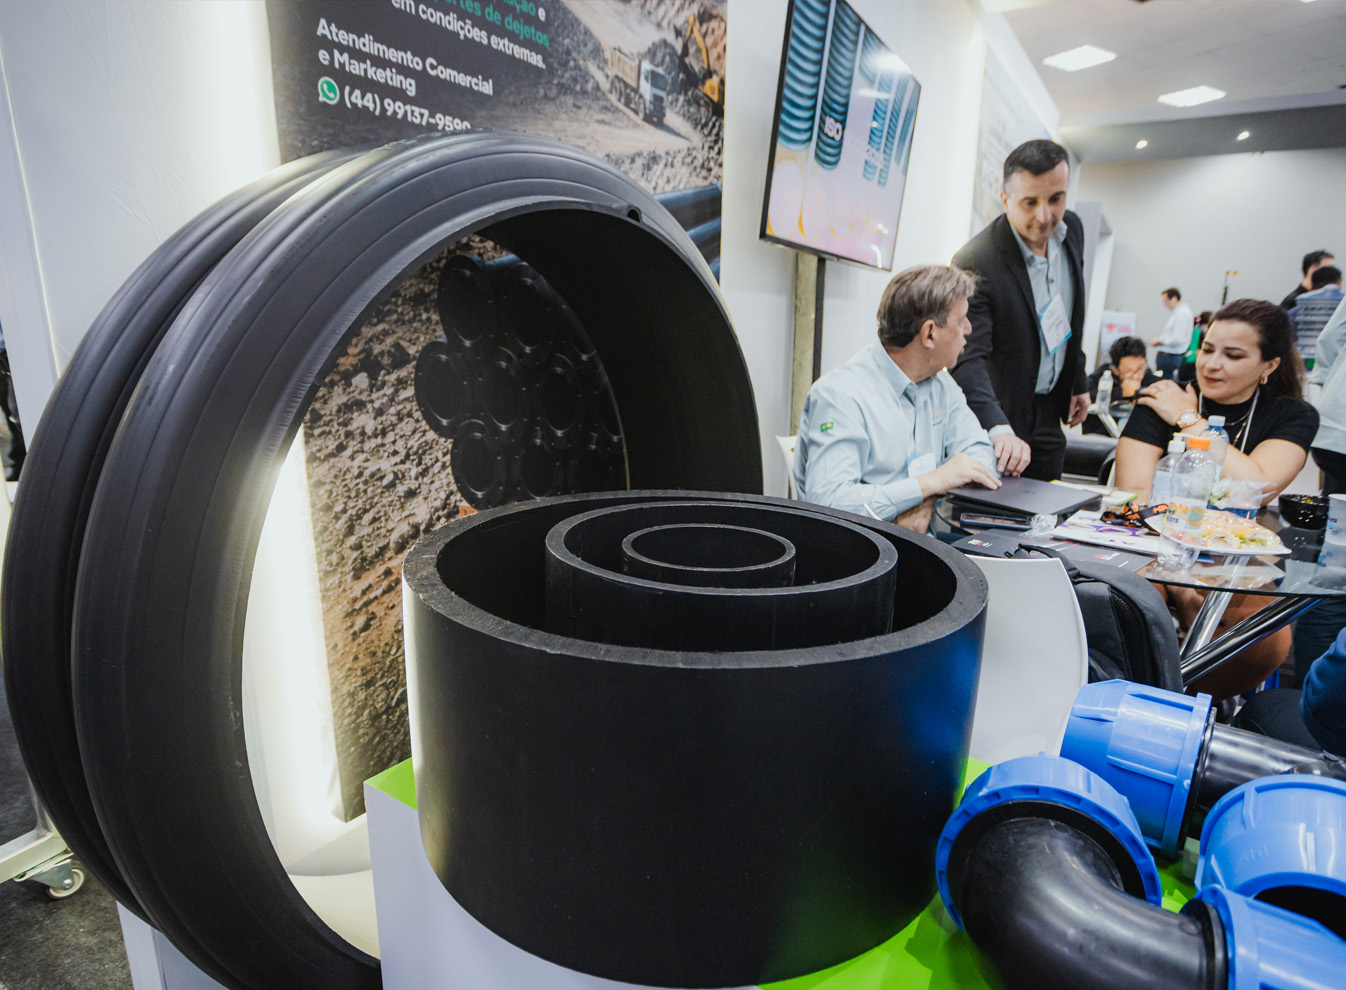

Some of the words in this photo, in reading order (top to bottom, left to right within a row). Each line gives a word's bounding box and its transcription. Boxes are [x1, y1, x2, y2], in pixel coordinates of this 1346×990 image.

[391, 0, 416, 16] em
[418, 3, 488, 45] condições
[490, 34, 546, 69] extremas.
[484, 4, 501, 26] de
[504, 13, 550, 47] dejetos
[538, 7, 546, 22] e
[316, 17, 423, 71] Atendimento
[425, 57, 494, 96] Comercial
[318, 49, 330, 65] e
[333, 49, 416, 97] Marketing
[343, 85, 381, 116] (44)
[824, 115, 842, 142] ISO
